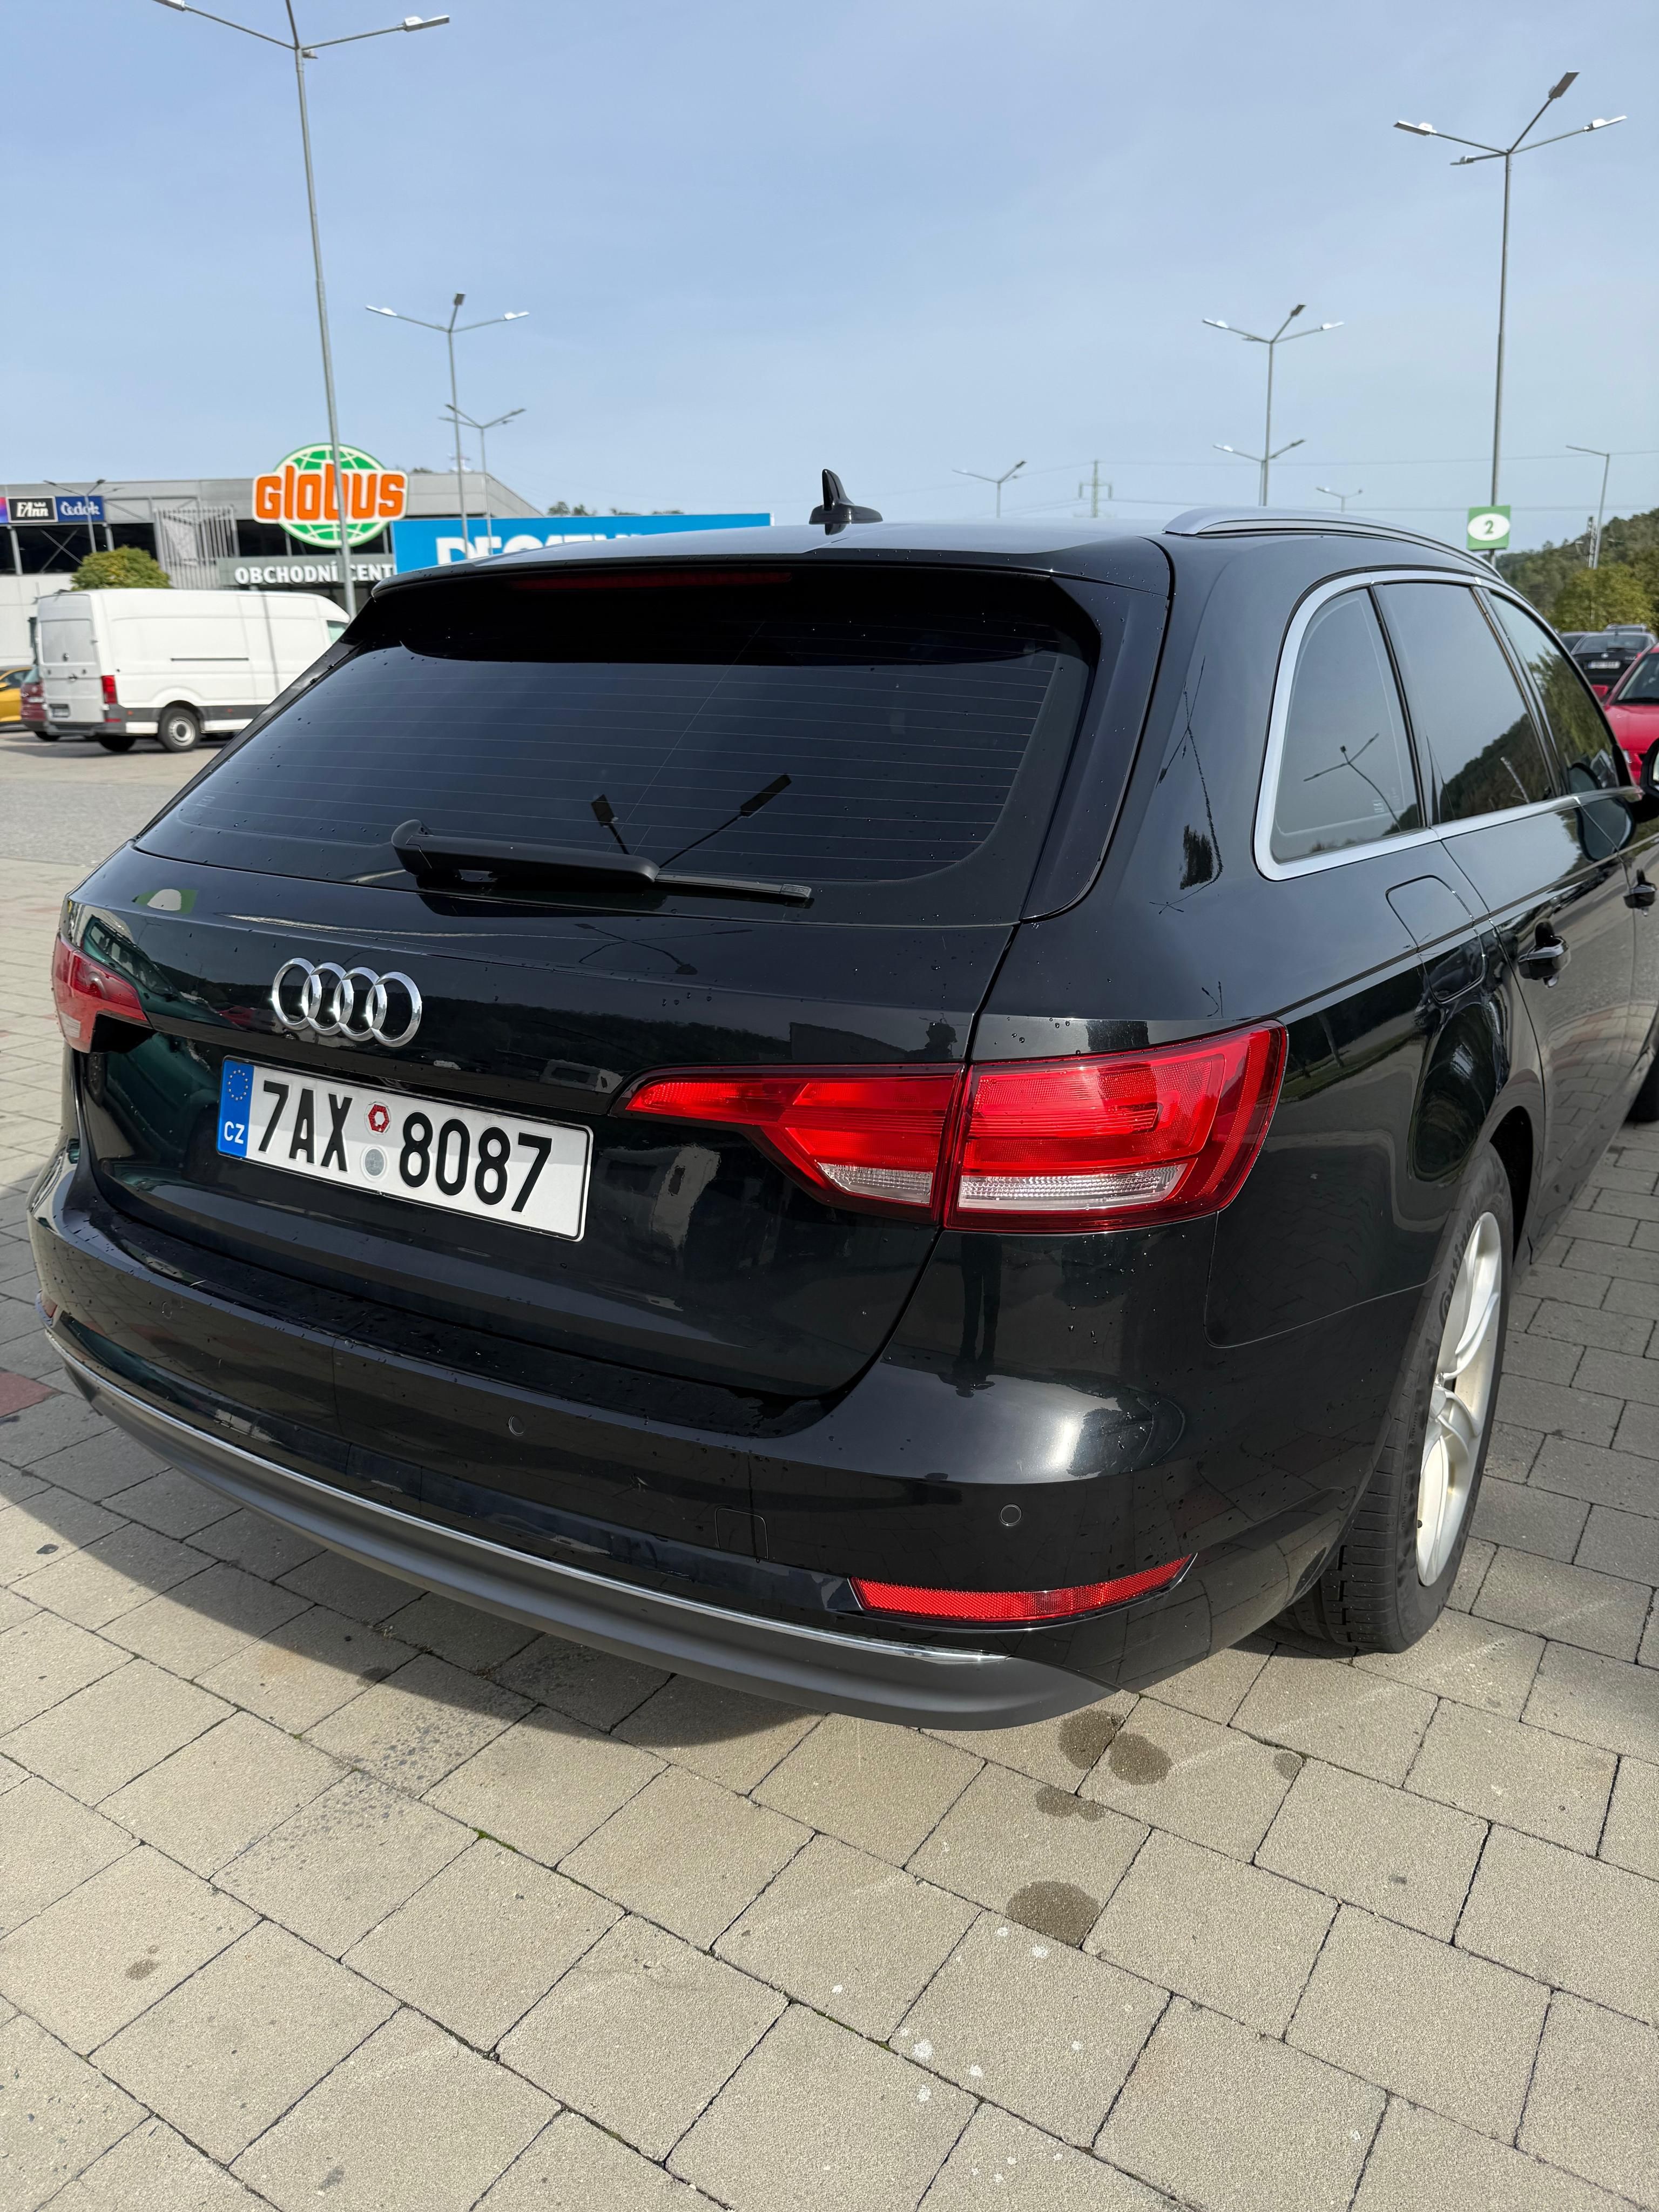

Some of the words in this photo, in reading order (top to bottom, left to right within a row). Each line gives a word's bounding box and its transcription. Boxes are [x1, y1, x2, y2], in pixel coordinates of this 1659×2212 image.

[256, 463, 405, 520] Globus
[60, 501, 100, 516] Čedok
[1485, 520, 1494, 534] 2
[234, 560, 339, 584] OBCHODNÍ
[224, 1121, 245, 1144] CZ
[258, 1080, 353, 1172] 7AX
[400, 1112, 552, 1212] 8087
